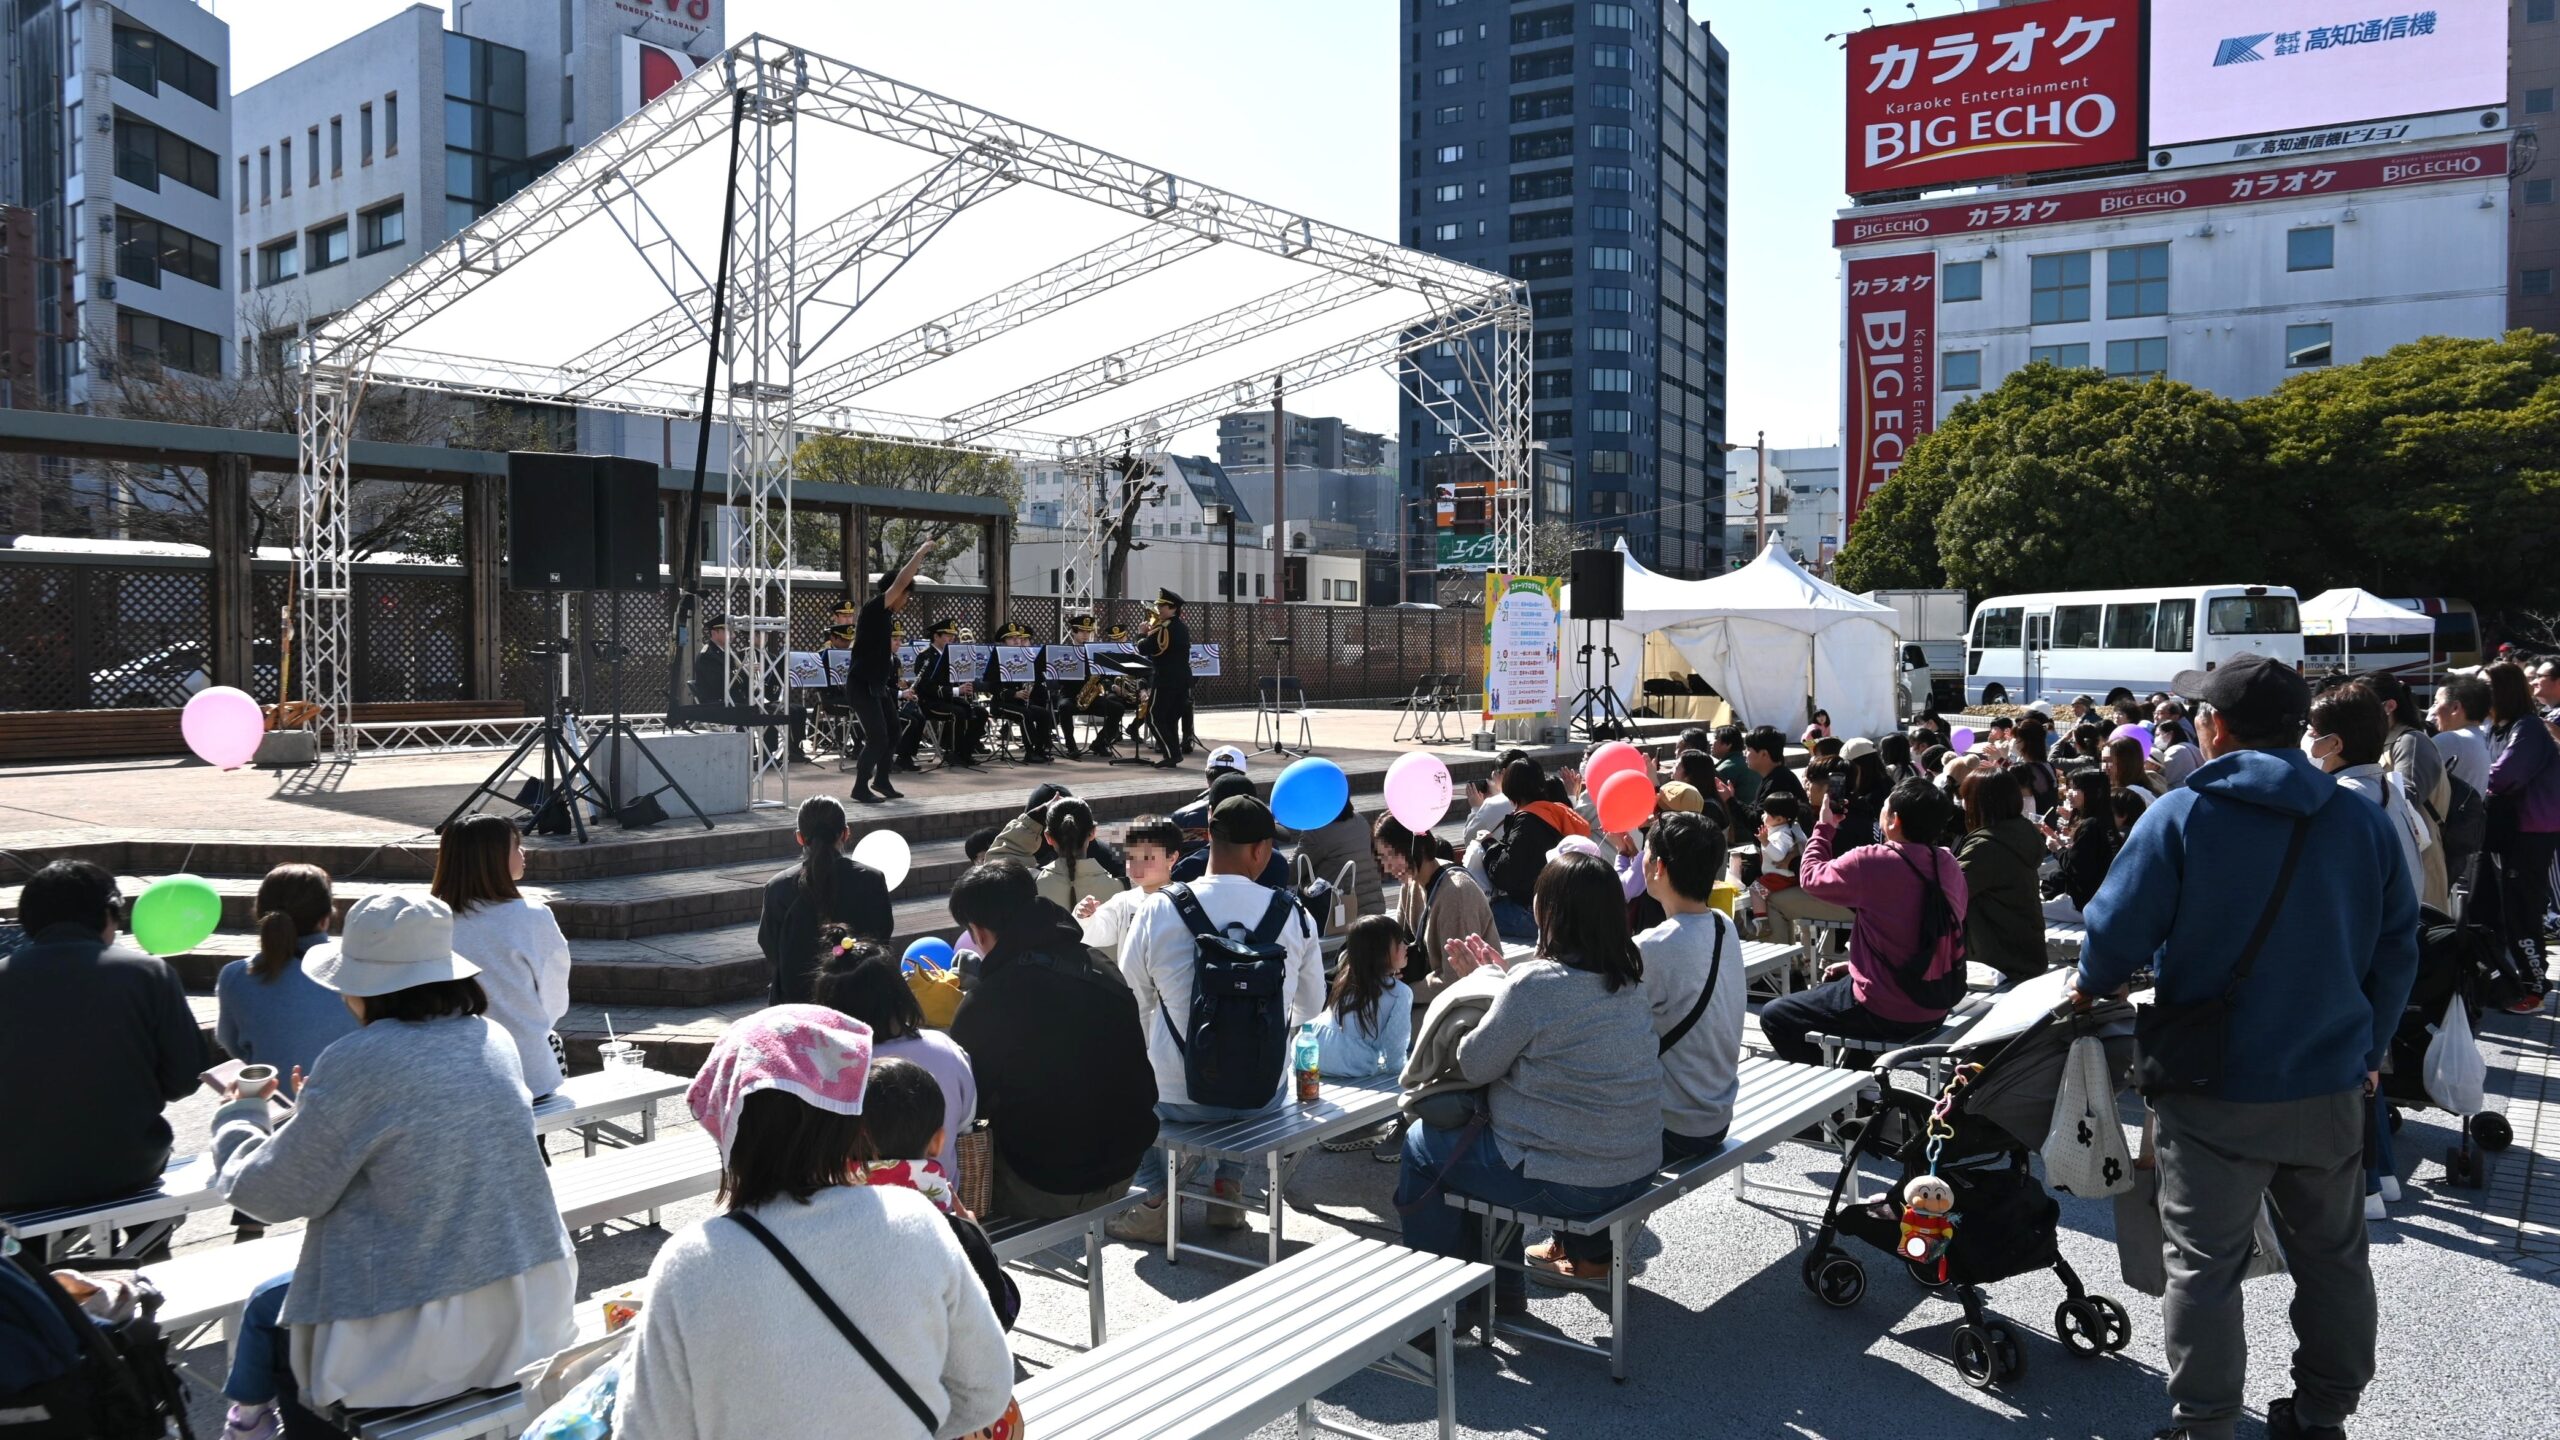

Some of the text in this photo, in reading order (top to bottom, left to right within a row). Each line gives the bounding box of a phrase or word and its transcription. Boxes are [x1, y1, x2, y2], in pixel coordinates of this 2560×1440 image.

[615, 2, 699, 33] WONDERFUL SQUARE
[2304, 10, 2437, 52] 高知通信機
[1865, 16, 2116, 94] カラオケ
[1886, 77, 2089, 115] Karaoke Entertainment
[1865, 93, 2116, 168] BIG ECHO
[2260, 125, 2409, 154] 高知通信機ビジョン
[2229, 170, 2337, 198] カラオケ
[2383, 156, 2481, 182] BIG ECHO
[1967, 200, 2060, 227] カラオケ
[2101, 189, 2187, 213] BIG ECHO
[1853, 218, 1930, 240] BIG ECHO
[1851, 274, 1932, 296] カラオケ
[1912, 328, 1926, 392] Karaoke
[1861, 309, 1907, 493] BIG ECH
